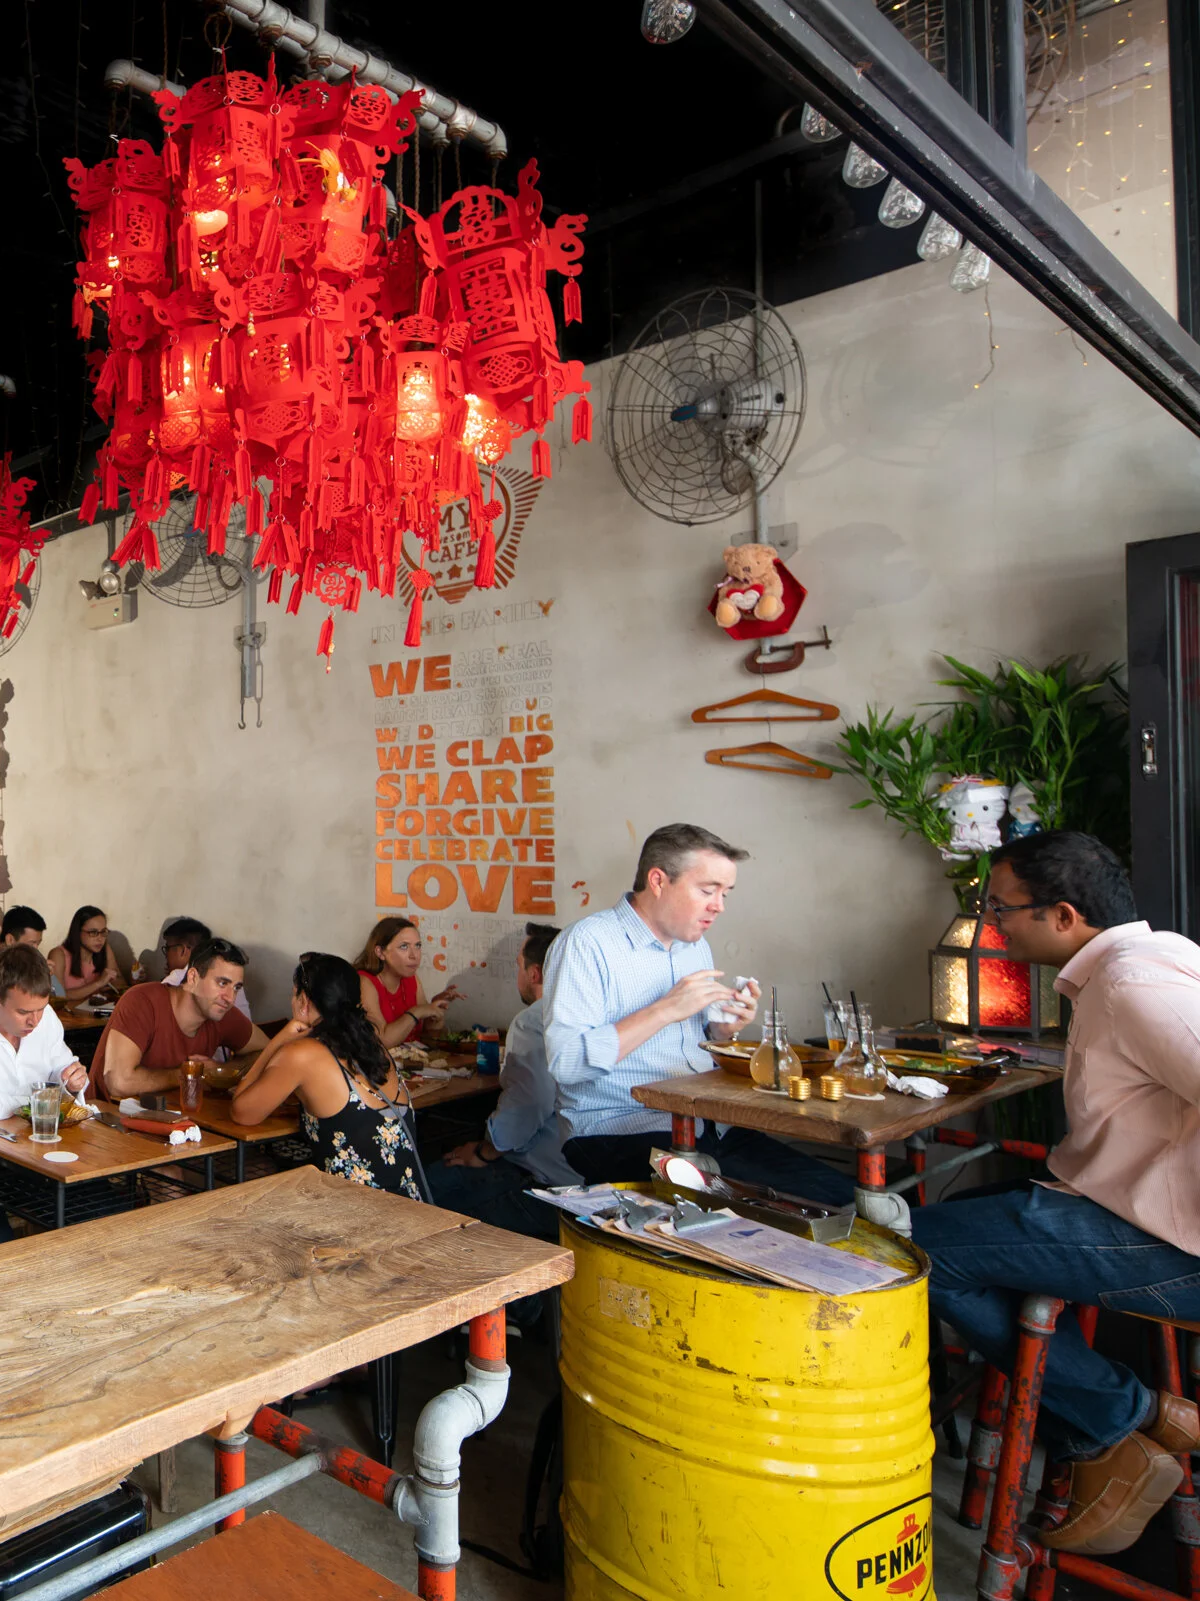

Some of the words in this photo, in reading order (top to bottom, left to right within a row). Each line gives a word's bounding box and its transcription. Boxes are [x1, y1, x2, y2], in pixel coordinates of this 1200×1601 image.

[428, 540, 478, 563] CAFE
[400, 615, 455, 637] HIS
[460, 598, 555, 630] FAMILY
[368, 654, 451, 698] WE
[375, 725, 411, 743] WE
[418, 717, 504, 741] DREAM
[509, 713, 554, 733] BIG
[375, 743, 436, 771] WE
[446, 734, 554, 767] CLAP
[375, 766, 555, 808] SHARE
[375, 807, 555, 837] FORGIVE
[375, 838, 555, 862] CELEBRATE
[375, 862, 556, 916] LOVE
